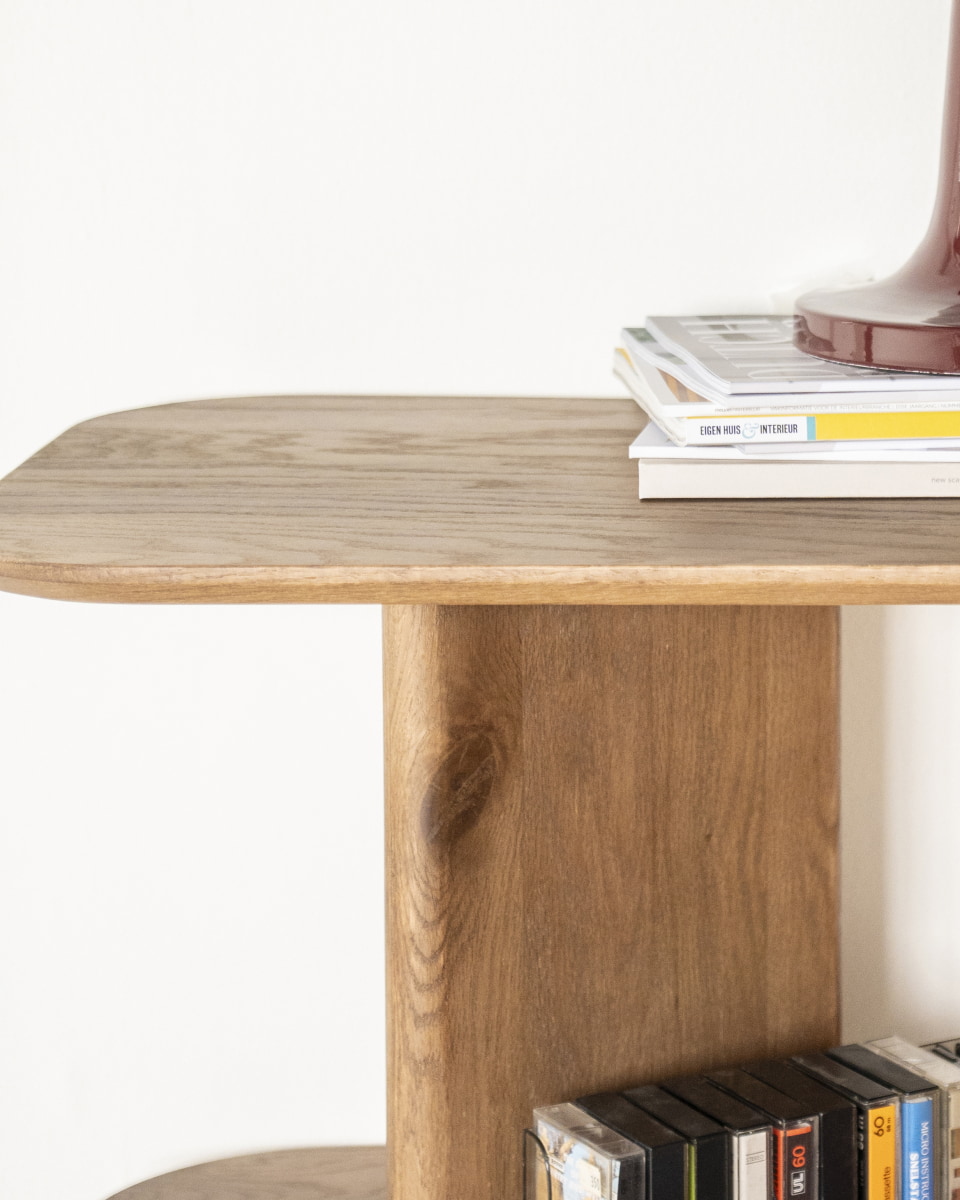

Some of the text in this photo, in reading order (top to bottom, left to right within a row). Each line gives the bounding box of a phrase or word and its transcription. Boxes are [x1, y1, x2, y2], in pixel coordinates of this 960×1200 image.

[700, 422, 798, 440] EIGEN HUIS & INTERIEUR
[873, 1116, 885, 1137] 60
[920, 1121, 929, 1155] MICRO
[792, 1145, 806, 1193] UL 60
